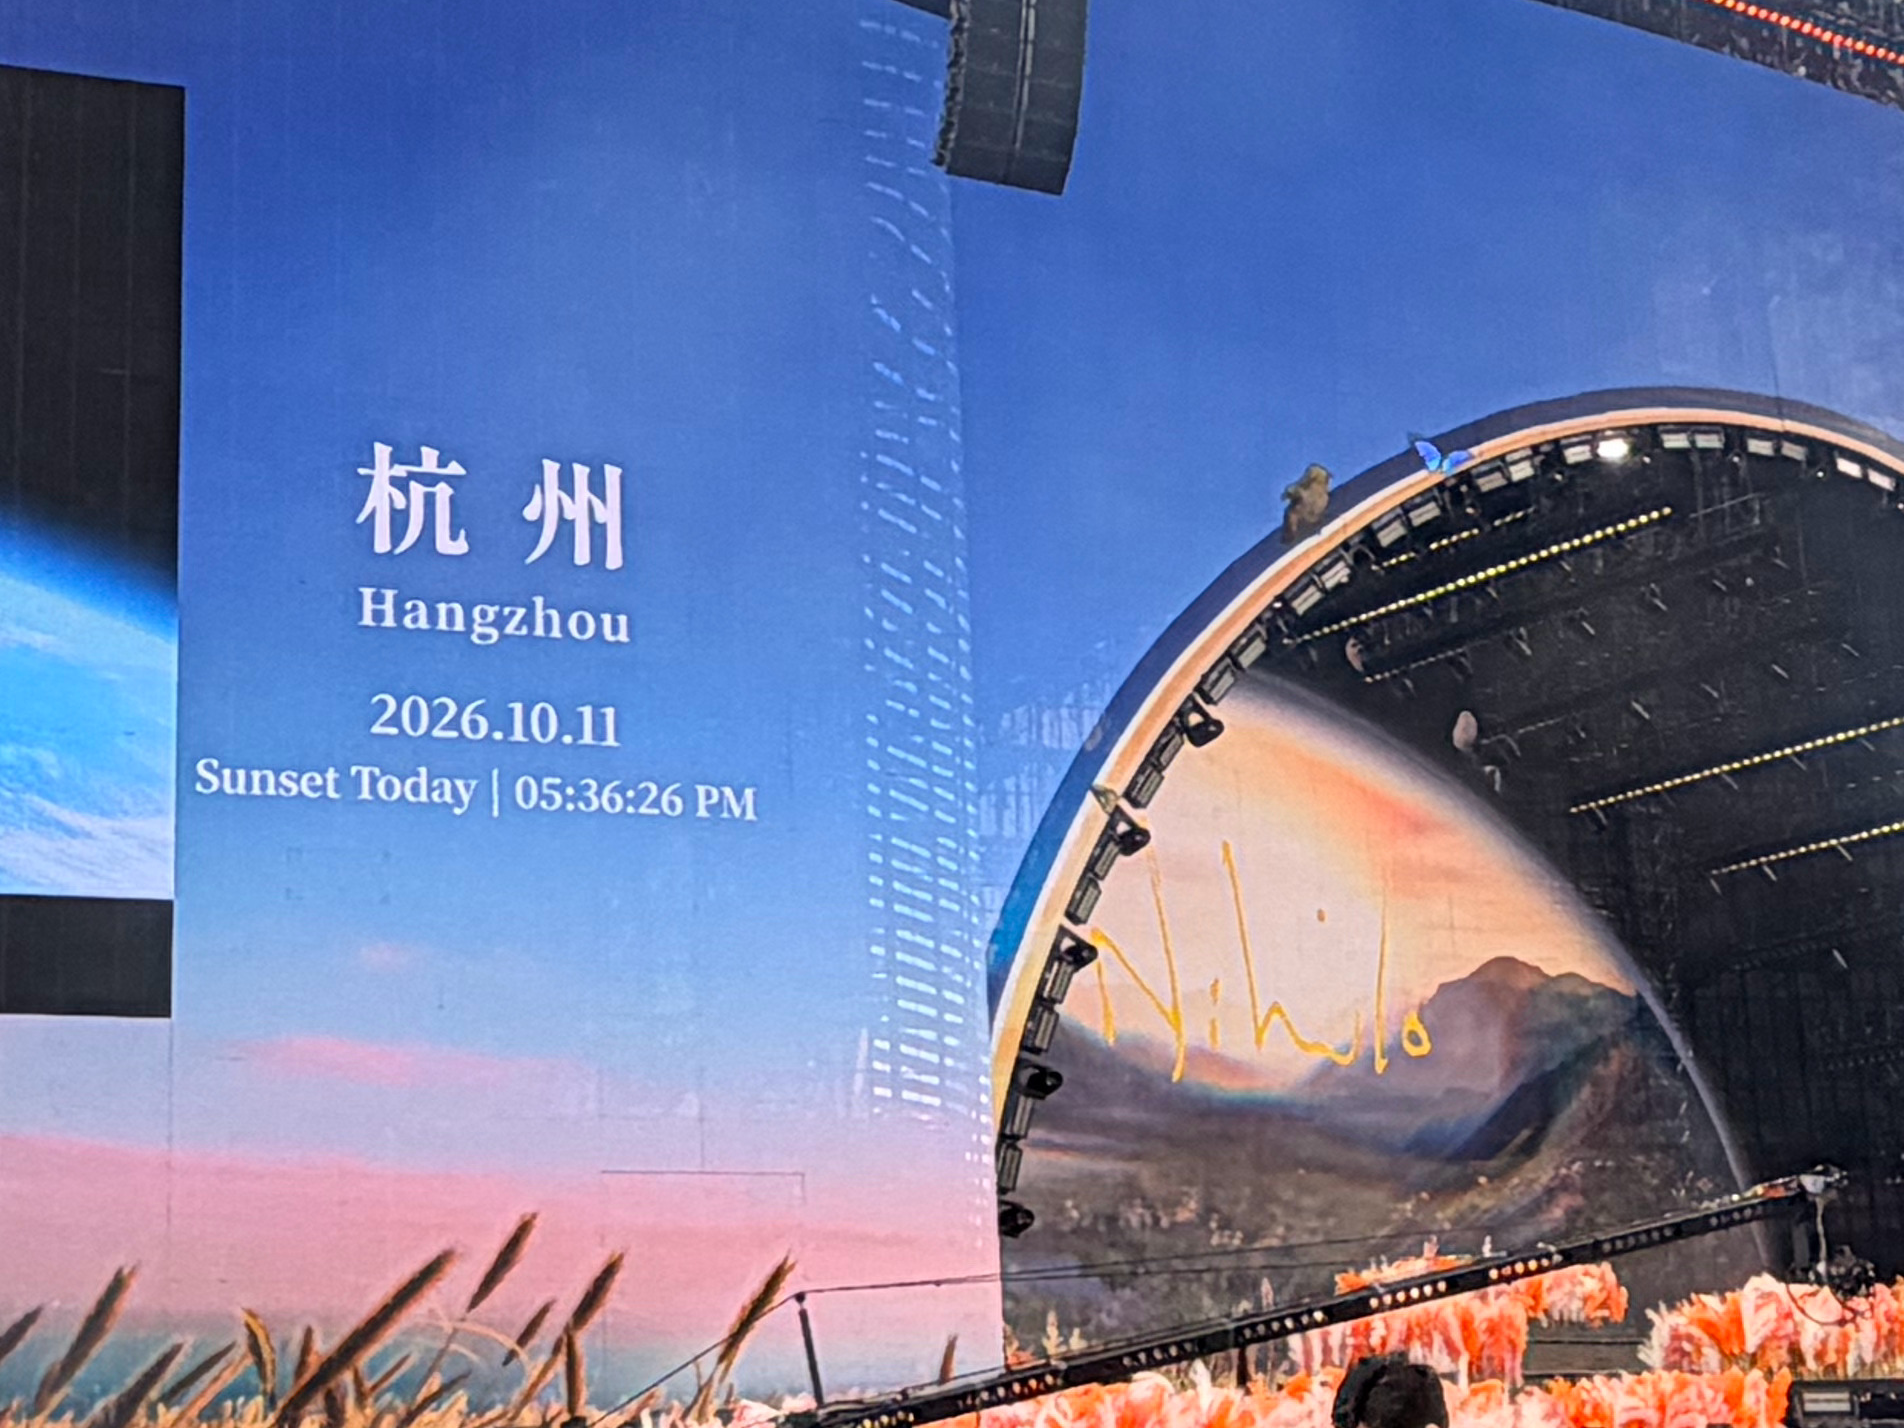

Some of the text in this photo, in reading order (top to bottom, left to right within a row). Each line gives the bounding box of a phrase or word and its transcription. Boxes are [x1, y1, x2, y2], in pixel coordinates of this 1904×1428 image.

[355, 440, 625, 571] 杭州
[357, 586, 631, 646] Hangzhou
[369, 692, 622, 748] 2026.10.11
[195, 757, 343, 800] Sunset
[349, 764, 481, 816] Today
[513, 774, 685, 818] 05:36:26
[693, 783, 759, 821] PM
